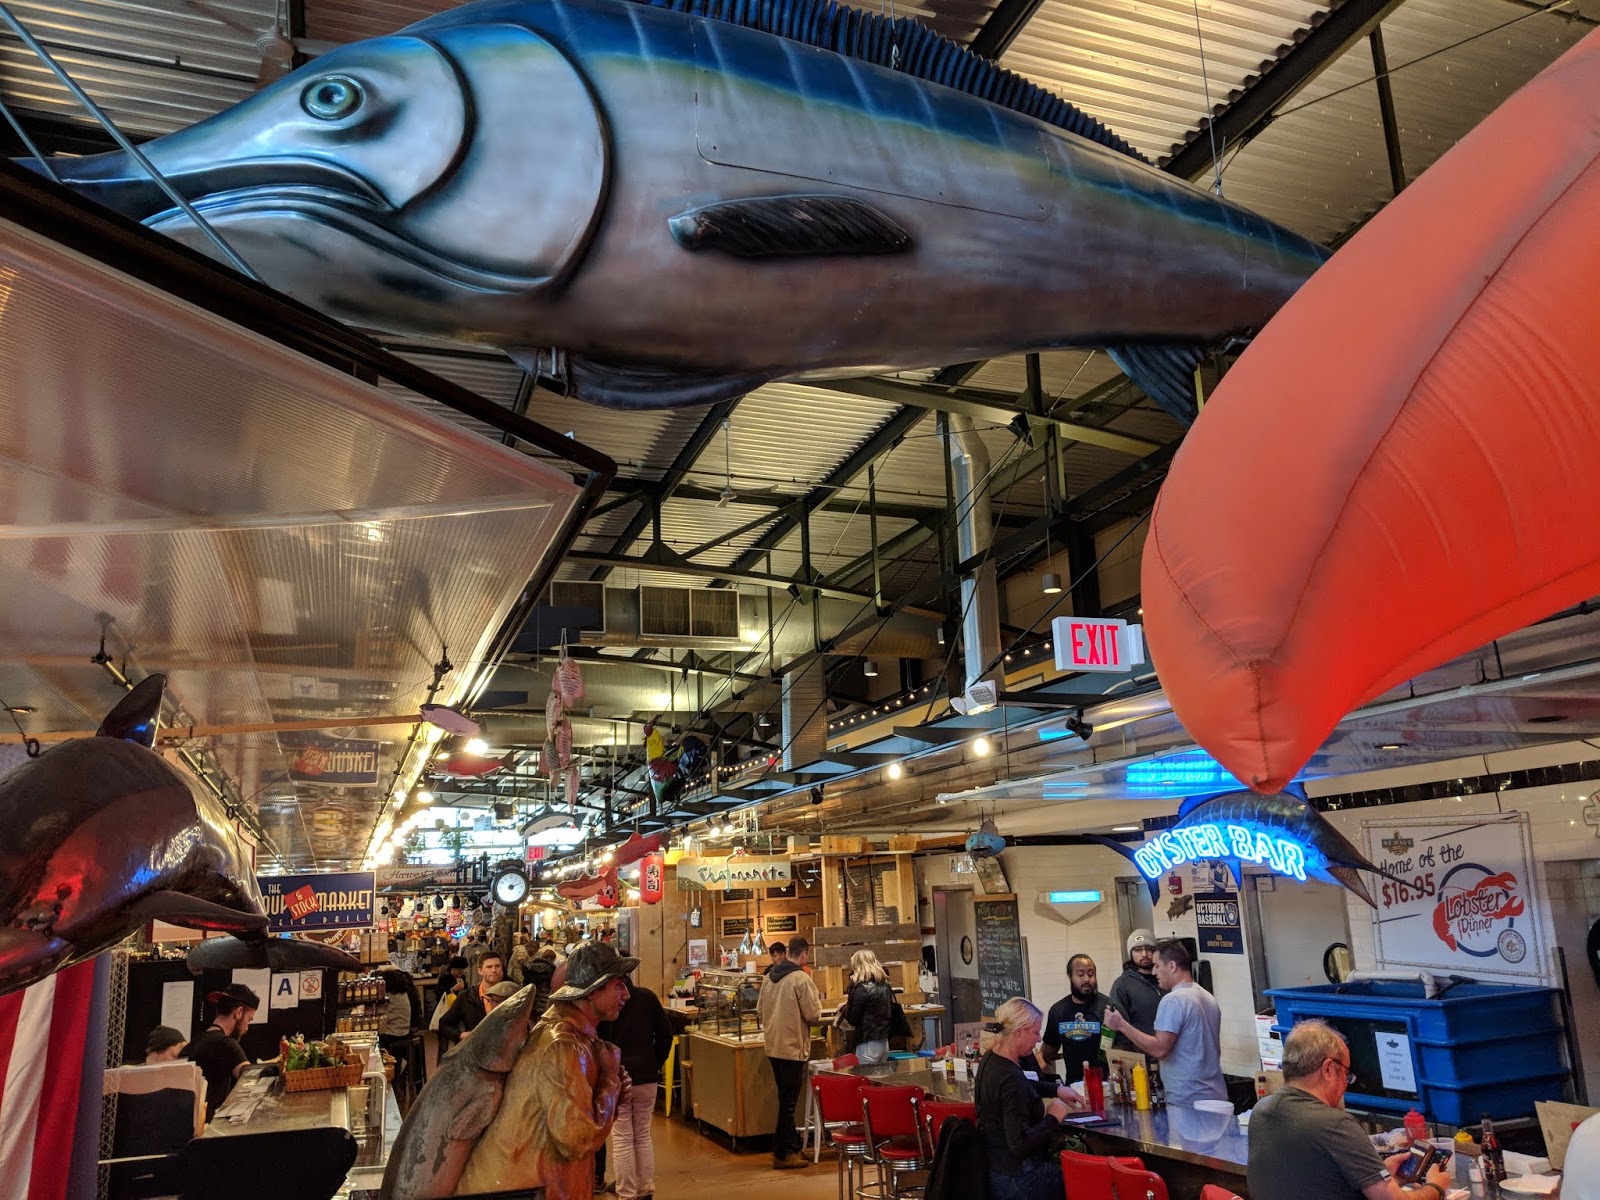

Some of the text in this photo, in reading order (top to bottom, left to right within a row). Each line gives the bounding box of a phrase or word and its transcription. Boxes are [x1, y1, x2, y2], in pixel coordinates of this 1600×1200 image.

[1070, 623, 1119, 666] EXIT
[528, 847, 545, 860] EXIT
[1134, 824, 1307, 882] OYSTER BAR
[1380, 844, 1465, 880] Home of the
[268, 883, 282, 894] THE
[1382, 873, 1436, 909] $16.95
[263, 895, 288, 916] OUP
[291, 895, 320, 918] STOCK
[315, 889, 373, 913] MARKET
[1196, 902, 1225, 914] OCTOBER
[1445, 888, 1504, 921] Lobster
[1197, 914, 1228, 925] BASEBALL
[1461, 916, 1495, 934] Dinner
[323, 929, 345, 945] Shopp
[276, 977, 293, 996] A
